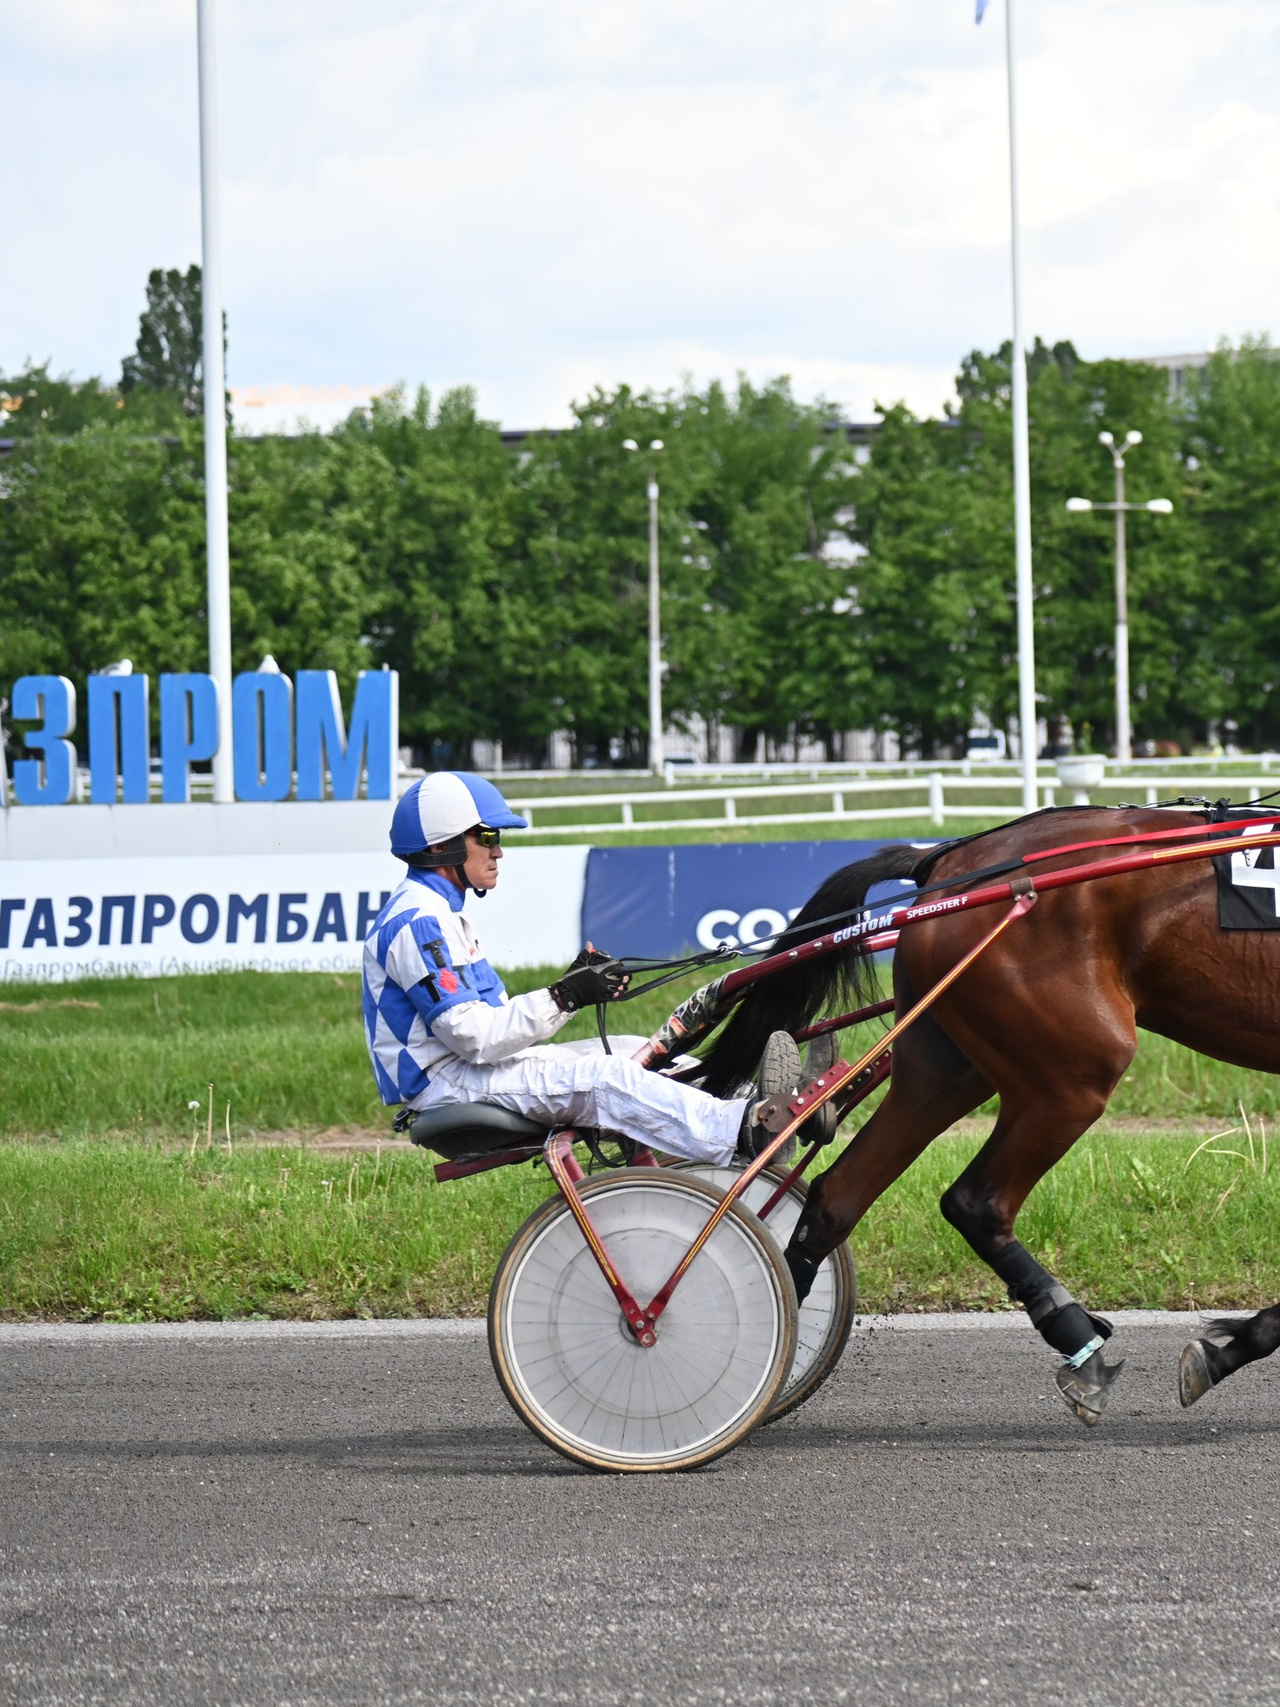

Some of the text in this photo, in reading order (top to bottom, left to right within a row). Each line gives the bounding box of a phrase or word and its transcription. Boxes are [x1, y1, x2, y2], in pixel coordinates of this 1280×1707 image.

[0, 669, 400, 805] ЗПРОМ
[0, 891, 391, 949] ГАЗПРОМБАН
[832, 896, 968, 943] CUSTOM SPEEDSTER F
